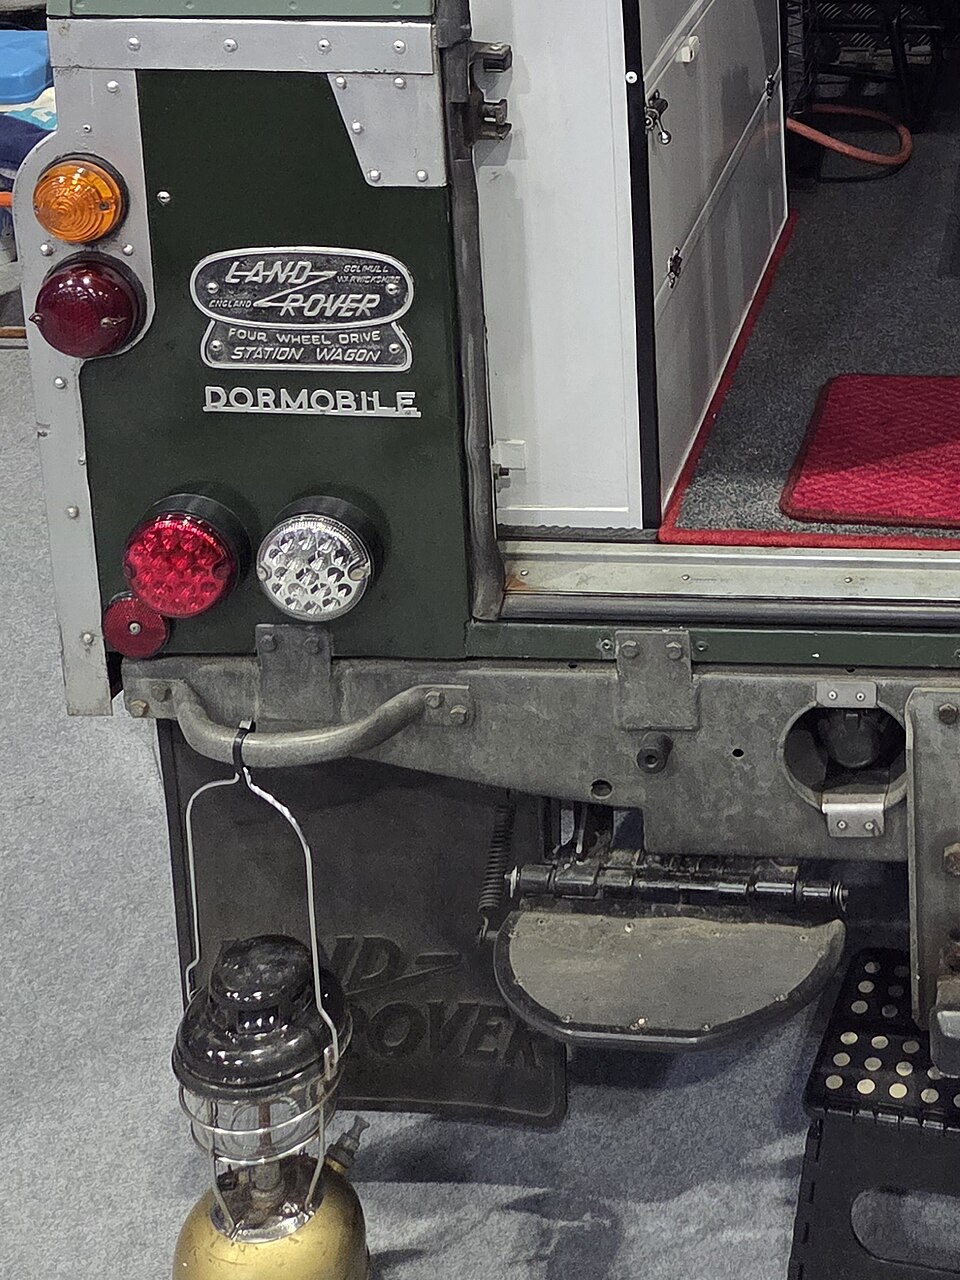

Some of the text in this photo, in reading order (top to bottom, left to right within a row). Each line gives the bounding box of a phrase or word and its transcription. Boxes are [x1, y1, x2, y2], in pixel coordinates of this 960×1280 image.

[225, 261, 312, 284] LAND
[343, 264, 389, 273] SOLIHULL
[209, 299, 252, 308] ENGLAND
[279, 293, 381, 317] ROVER
[228, 327, 382, 345] FOUR WHEEL DRIVE
[231, 346, 381, 363] STATION WAGON
[204, 386, 420, 416] DORMOBILE
